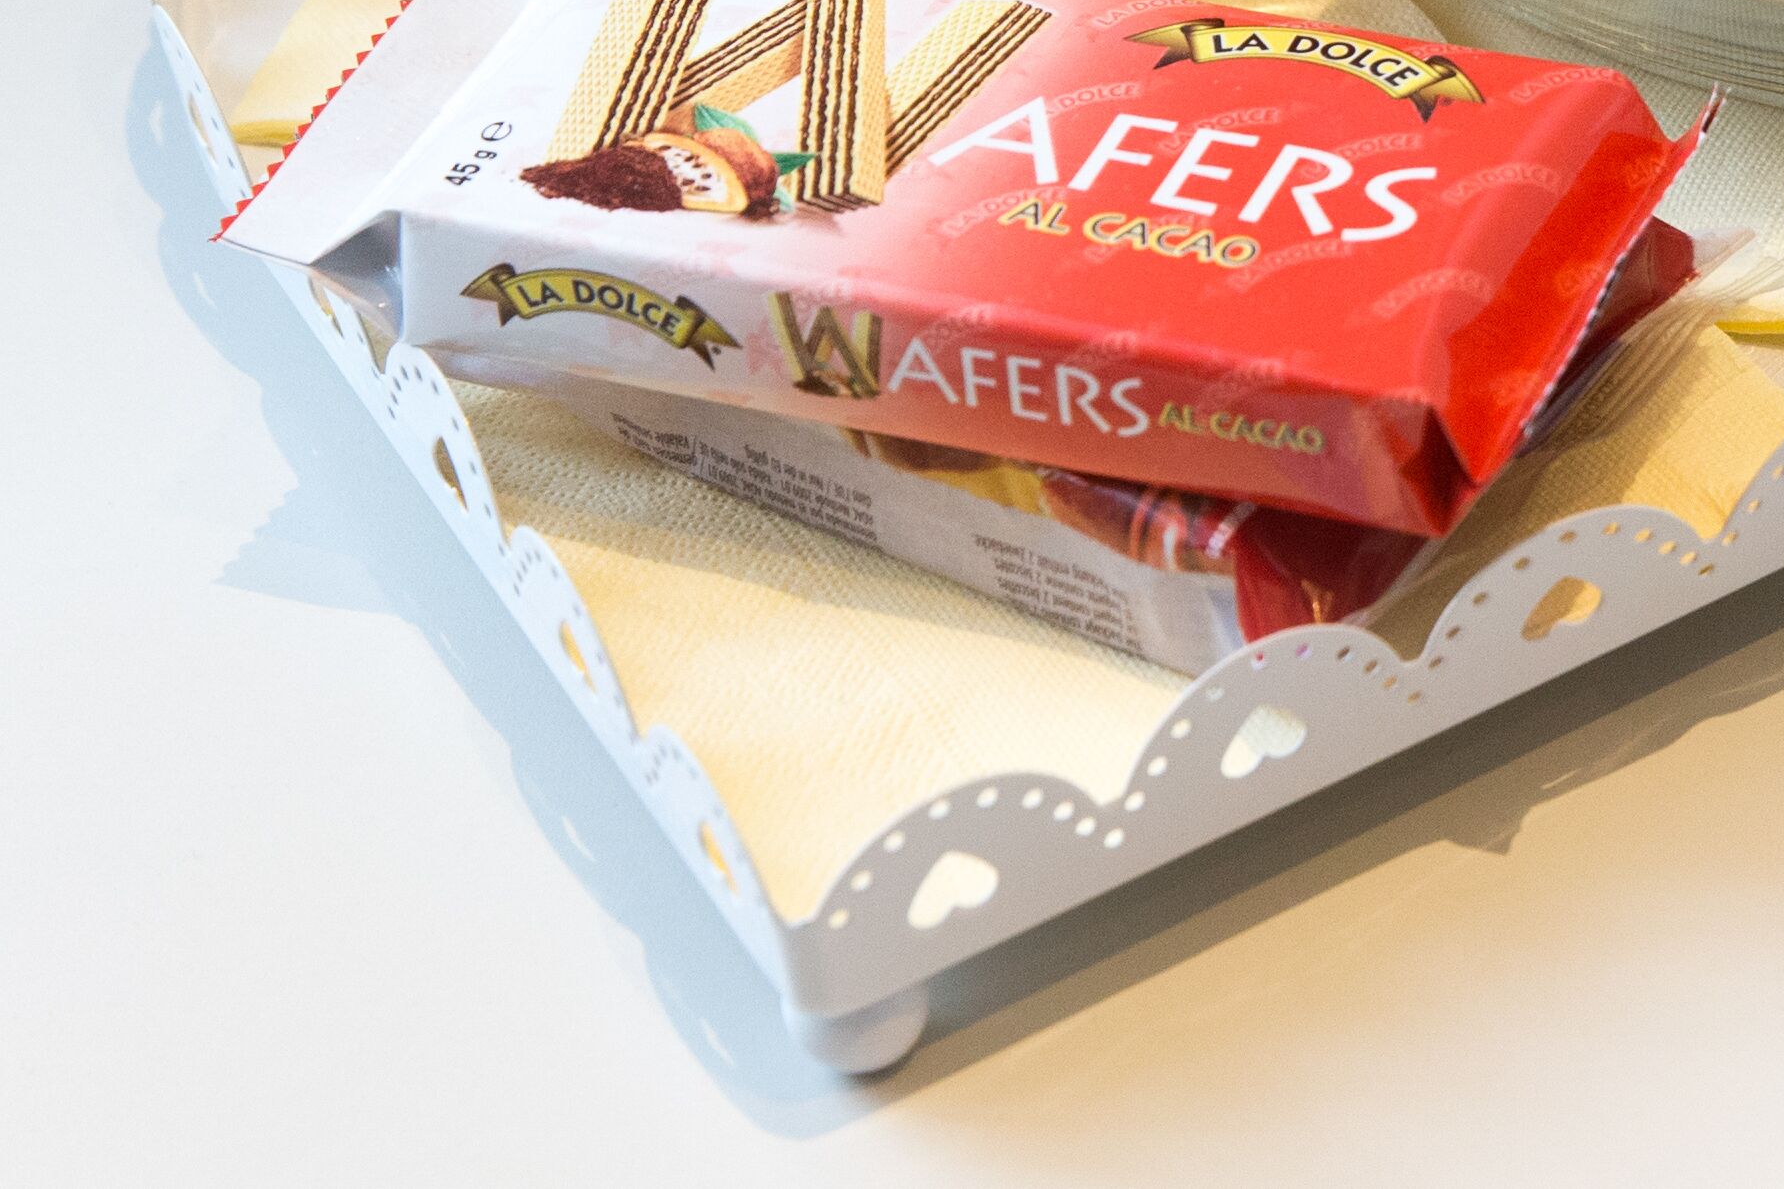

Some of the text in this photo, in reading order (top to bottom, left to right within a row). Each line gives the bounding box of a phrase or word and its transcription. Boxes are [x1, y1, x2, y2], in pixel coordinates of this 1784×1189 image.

[1212, 33, 1420, 89] LA DOLCE
[445, 162, 481, 188] 45
[474, 149, 498, 161] g
[998, 197, 1262, 269] AL CACAO
[516, 278, 681, 338] LA DOLCE
[1158, 401, 1202, 435] AL
[1209, 409, 1326, 456] CACAO
